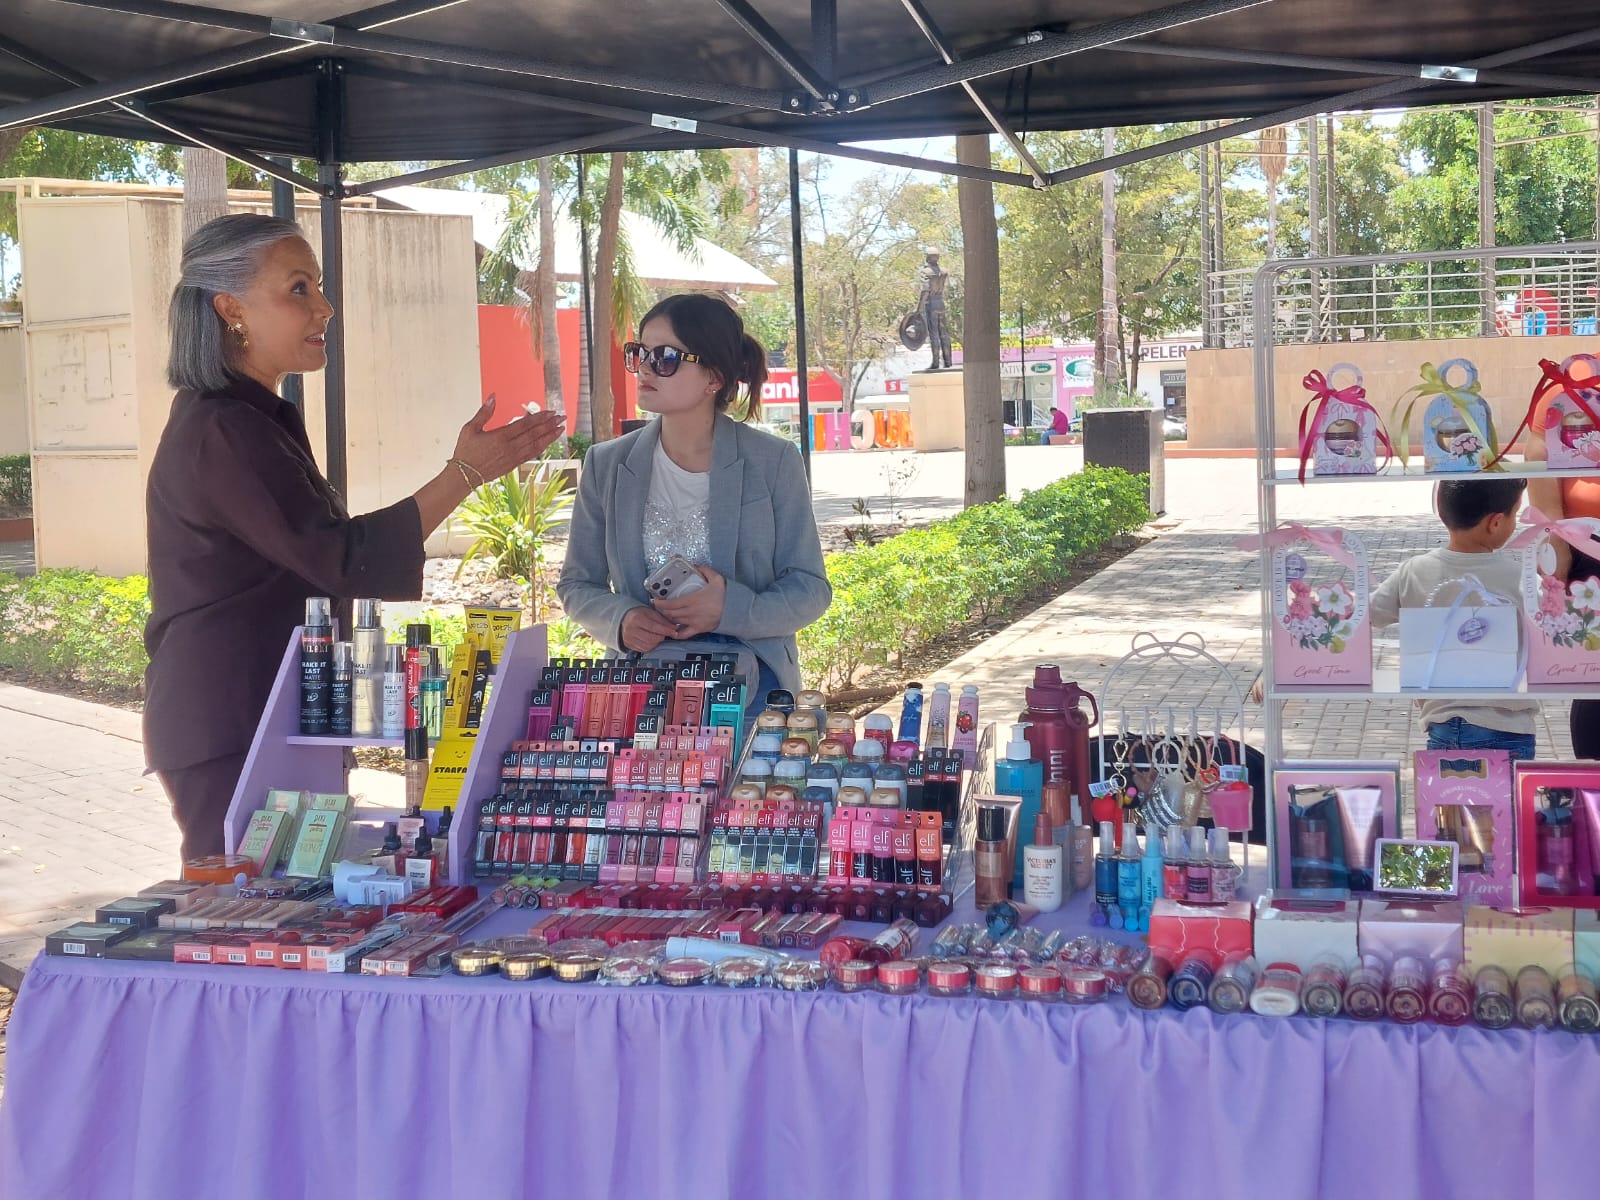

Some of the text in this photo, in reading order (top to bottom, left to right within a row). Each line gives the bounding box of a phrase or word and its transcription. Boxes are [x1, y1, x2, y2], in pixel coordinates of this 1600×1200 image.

[545, 669, 560, 680] elf
[568, 669, 584, 682] elf
[591, 670, 606, 683] elf
[613, 670, 629, 682] elf
[635, 670, 651, 682] elf
[681, 663, 701, 678] elf
[710, 663, 730, 679] elf
[533, 692, 549, 705] elf
[648, 692, 665, 705] elf
[717, 686, 737, 702] elf
[639, 717, 656, 731] elf
[550, 728, 564, 740] elf
[660, 737, 673, 749] elf
[678, 738, 692, 749] elf
[696, 738, 709, 750] elf
[504, 753, 518, 765] elf
[522, 753, 537, 765] elf
[540, 753, 554, 765] elf
[556, 754, 571, 766] elf
[574, 754, 588, 766] elf
[592, 755, 606, 767] elf
[703, 759, 718, 770] elf
[614, 761, 628, 774] elf
[632, 761, 646, 774] elf
[649, 762, 664, 774] elf
[666, 762, 680, 775] elf
[684, 763, 699, 775] elf
[908, 763, 923, 776] elf
[928, 761, 939, 771] elf
[945, 761, 959, 773] elf
[481, 801, 496, 814] elf
[499, 801, 514, 814] elf
[517, 802, 532, 814] elf
[536, 802, 551, 815] elf
[554, 803, 570, 815] elf
[571, 803, 586, 816] elf
[590, 804, 605, 817] elf
[608, 804, 623, 816] elf
[627, 804, 642, 817] elf
[646, 805, 661, 817] elf
[664, 806, 679, 818] elf
[683, 807, 697, 819] elf
[713, 813, 728, 825] elf
[728, 813, 742, 825] elf
[743, 813, 757, 825] elf
[758, 813, 772, 825] elf
[773, 813, 787, 825] elf
[788, 814, 802, 826] elf
[803, 814, 818, 826] elf
[831, 825, 847, 838] elf
[853, 825, 869, 838] elf
[873, 830, 890, 844] elf
[894, 833, 911, 847] elf
[919, 833, 935, 847] elf
[900, 867, 913, 885] elf
[920, 867, 933, 885] elf
